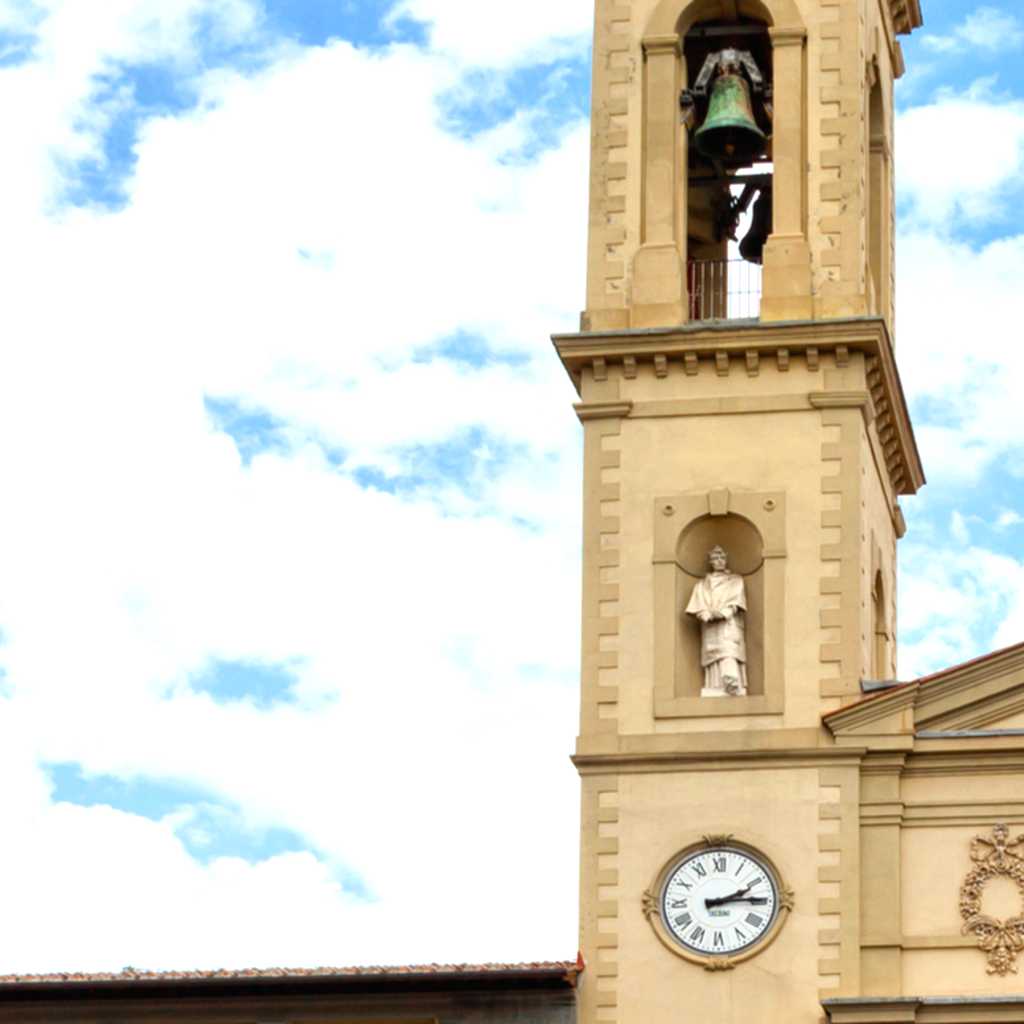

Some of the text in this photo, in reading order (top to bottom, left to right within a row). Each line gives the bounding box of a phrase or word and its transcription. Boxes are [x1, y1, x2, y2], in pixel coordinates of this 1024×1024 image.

[713, 857, 726, 872] XII
[677, 878, 693, 891] X
[734, 928, 746, 941] V
